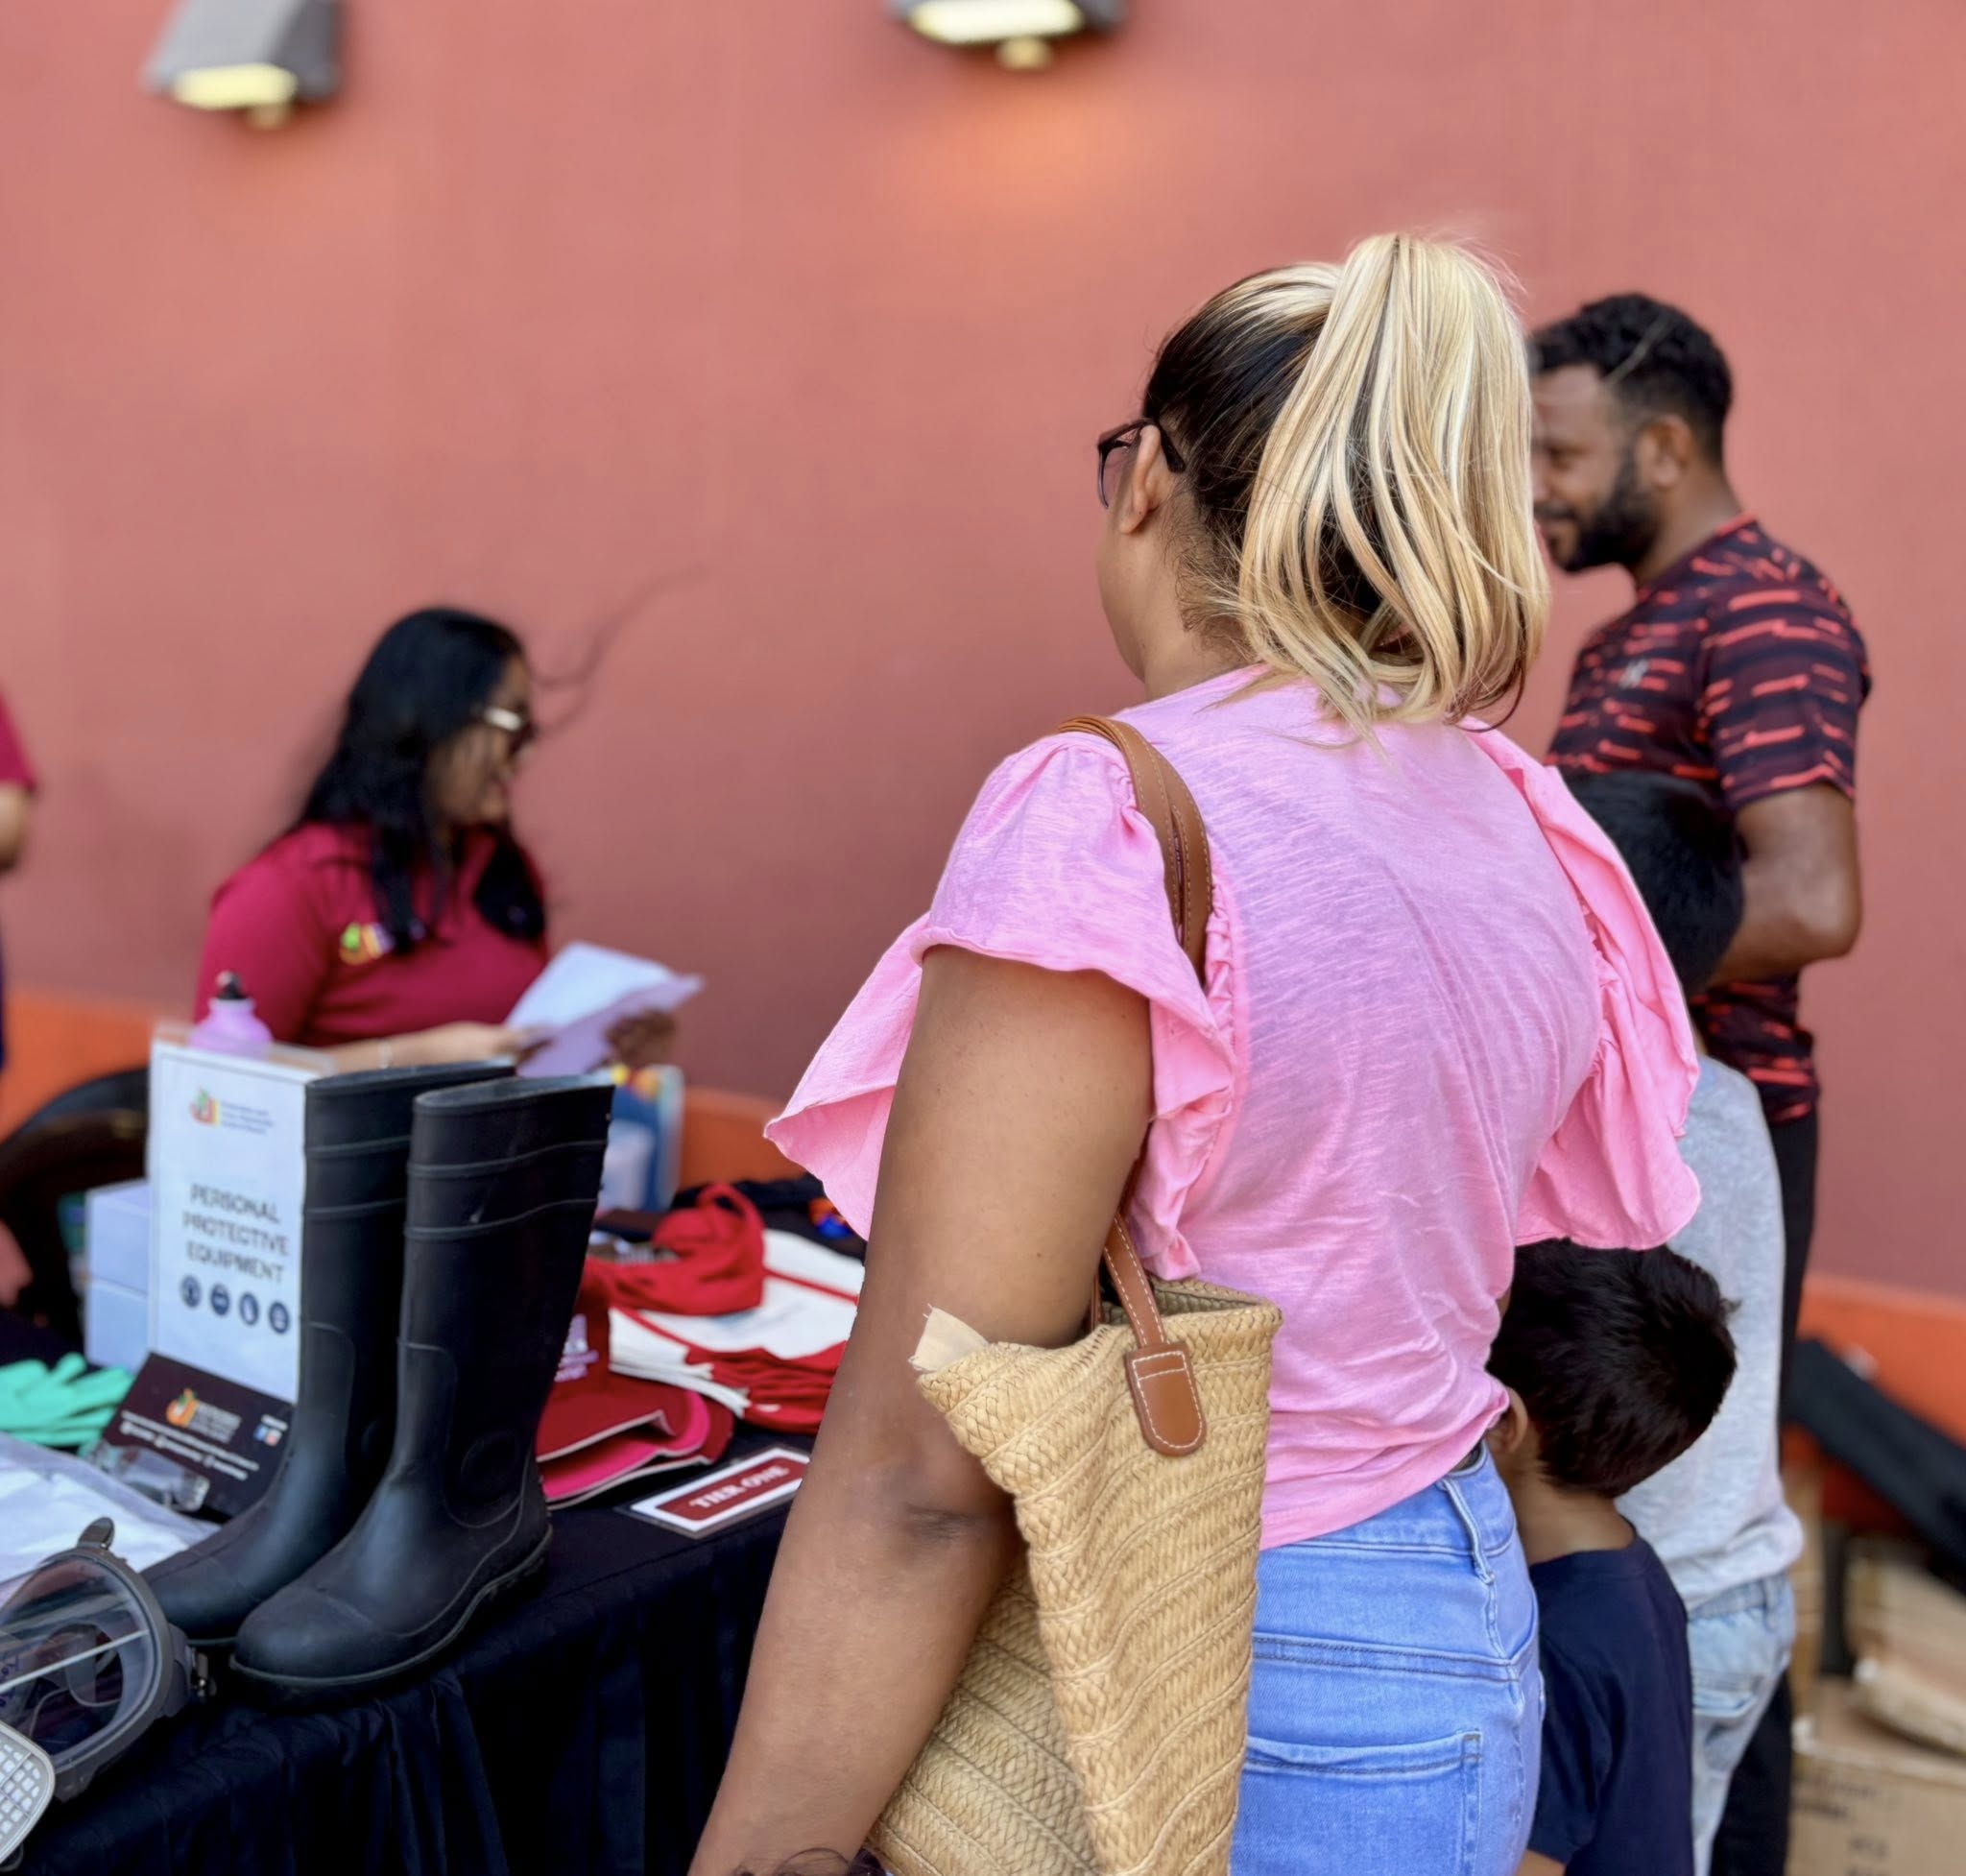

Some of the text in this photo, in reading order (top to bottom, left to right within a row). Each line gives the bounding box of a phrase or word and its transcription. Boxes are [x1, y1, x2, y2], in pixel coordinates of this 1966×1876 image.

[191, 1183, 280, 1224] PERSONAL
[182, 1210, 289, 1257] PROTECTIVE
[186, 1240, 284, 1284] EQUIPMENT
